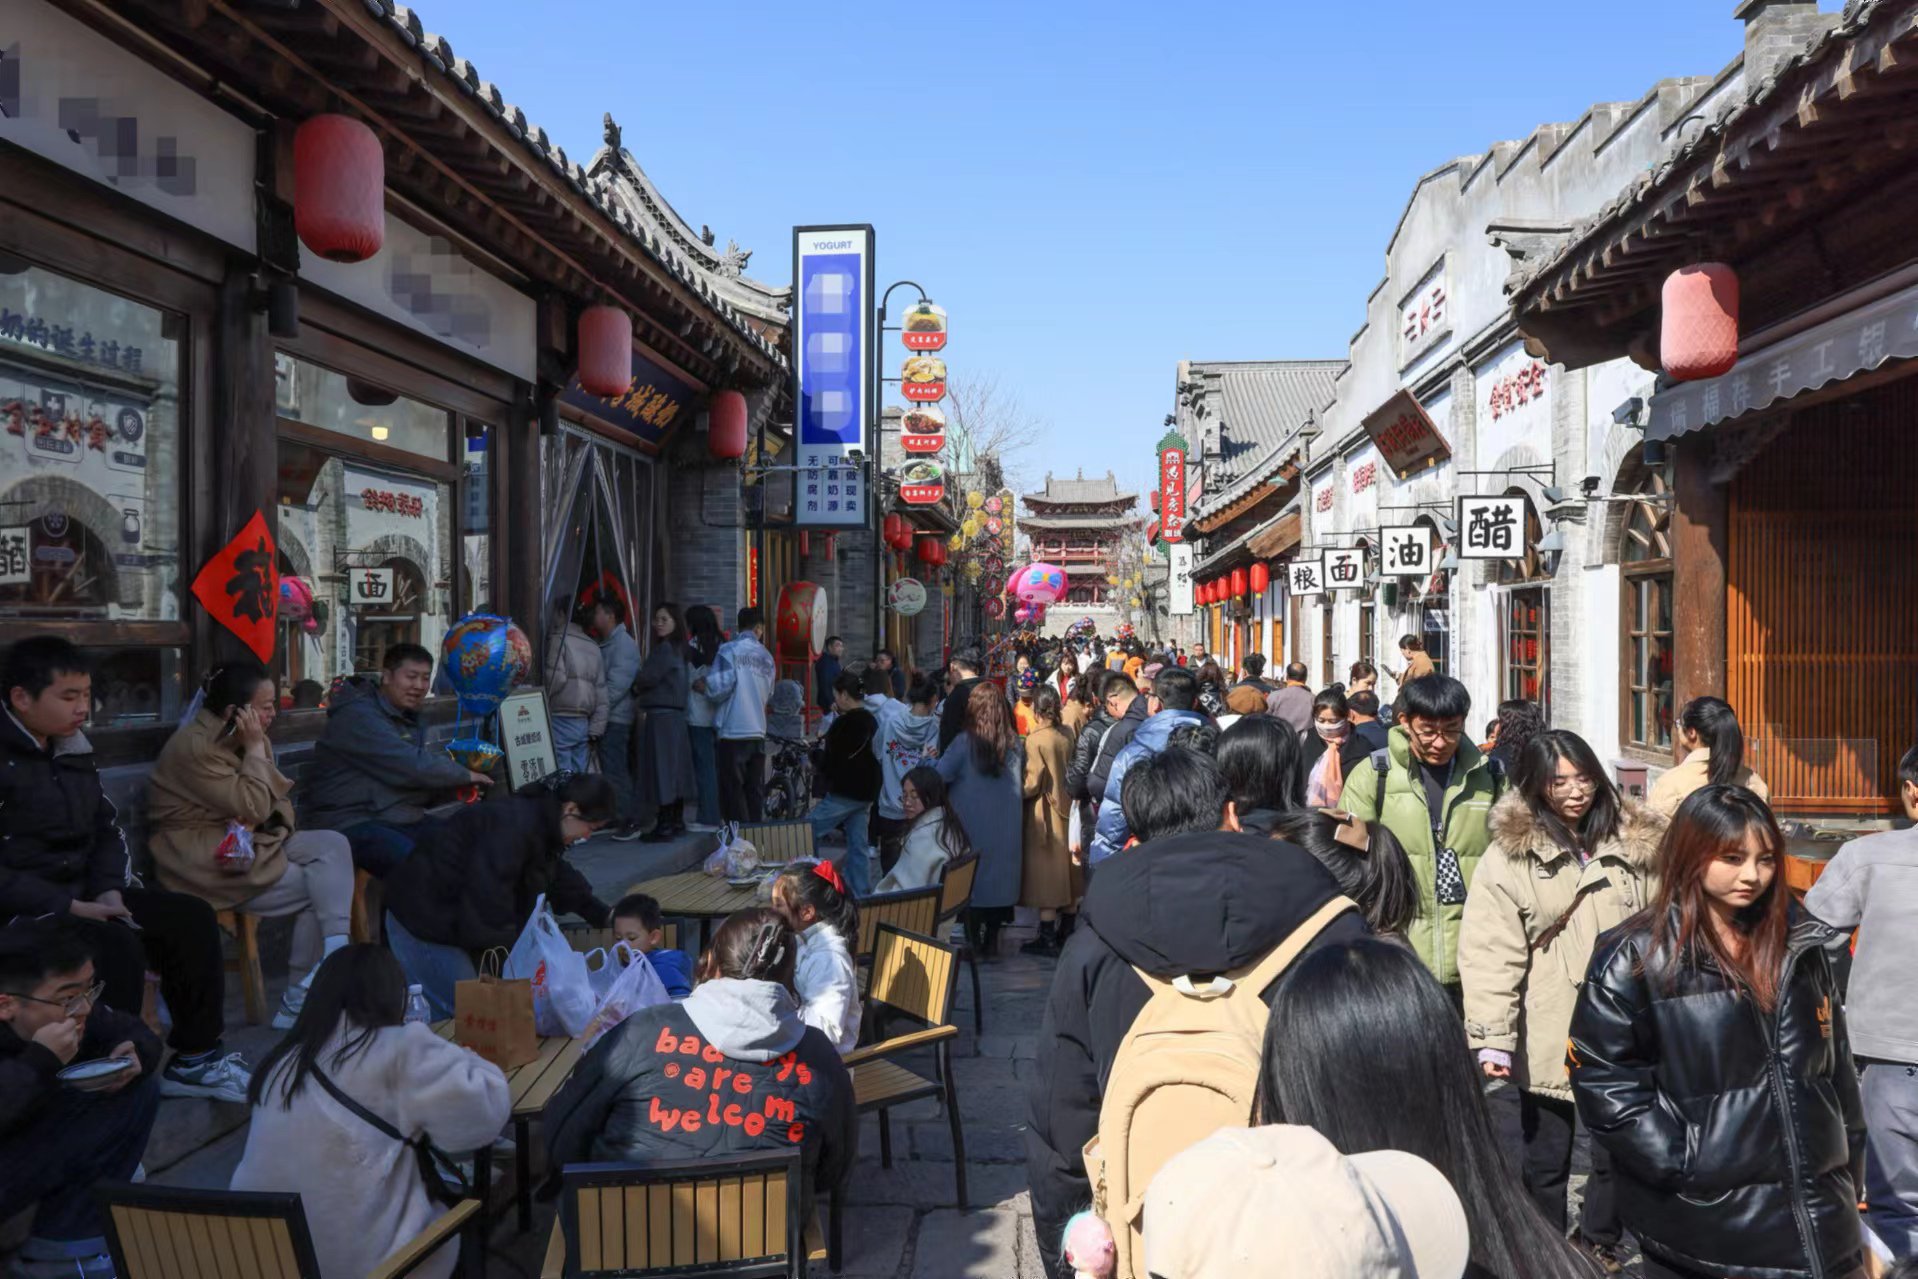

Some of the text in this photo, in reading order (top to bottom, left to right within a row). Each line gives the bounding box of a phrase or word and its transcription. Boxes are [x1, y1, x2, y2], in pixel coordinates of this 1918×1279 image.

[813, 241, 852, 250] YOGURT
[1670, 312, 1918, 434] 瑞福祥手工银
[807, 456, 819, 512] 无防腐剂
[827, 456, 839, 512] 可靠奶源
[1468, 504, 1517, 551] 醋
[1330, 554, 1358, 582] 面
[1389, 534, 1423, 568] 油
[1294, 566, 1319, 590] 粮
[683, 1066, 753, 1094] are
[761, 1051, 812, 1085] ys
[650, 1093, 804, 1143] welcome
